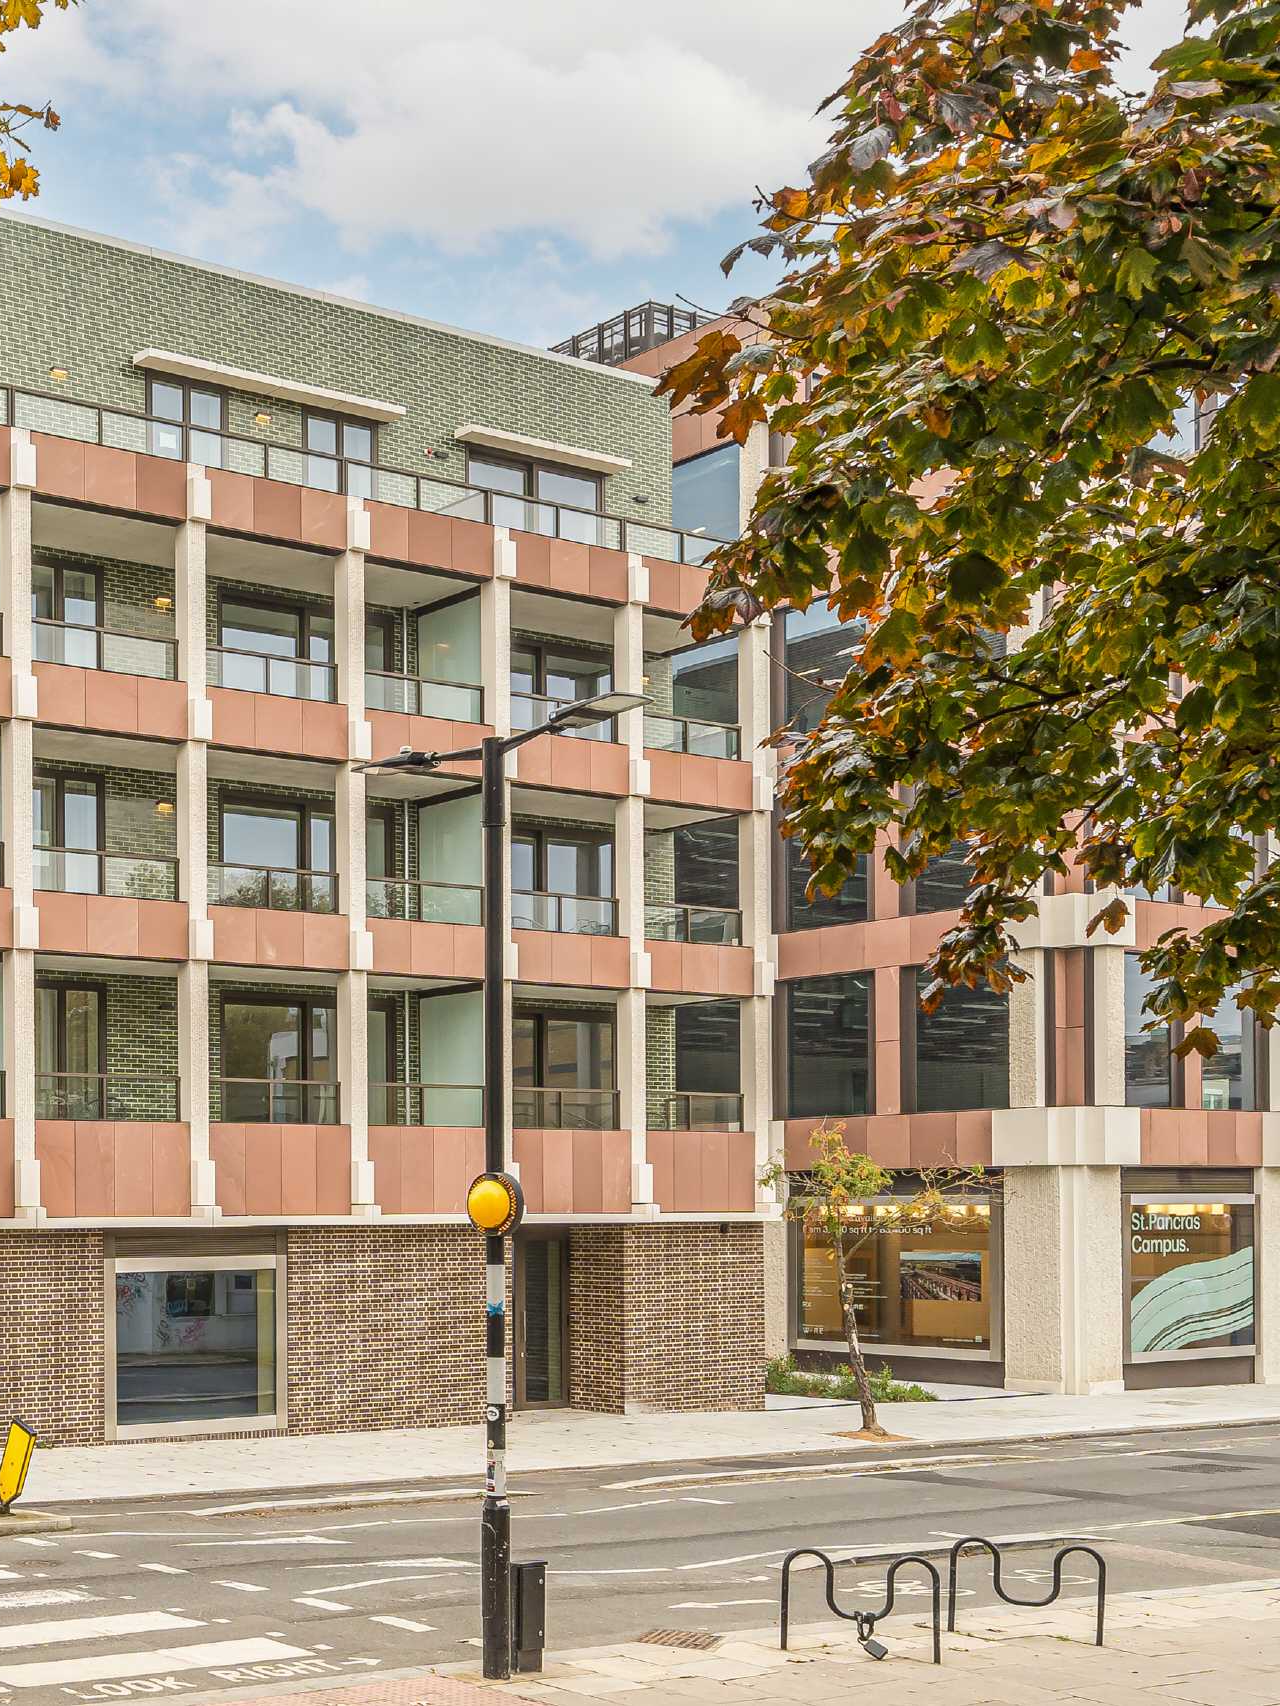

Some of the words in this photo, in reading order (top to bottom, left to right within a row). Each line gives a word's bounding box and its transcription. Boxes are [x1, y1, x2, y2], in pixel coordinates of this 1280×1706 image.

[912, 1227, 924, 1236] sq
[924, 1225, 932, 1234] ft
[1131, 1235, 1190, 1257] Campus.
[61, 1675, 197, 1700] LOOK
[208, 1659, 342, 1683] RIGHT
